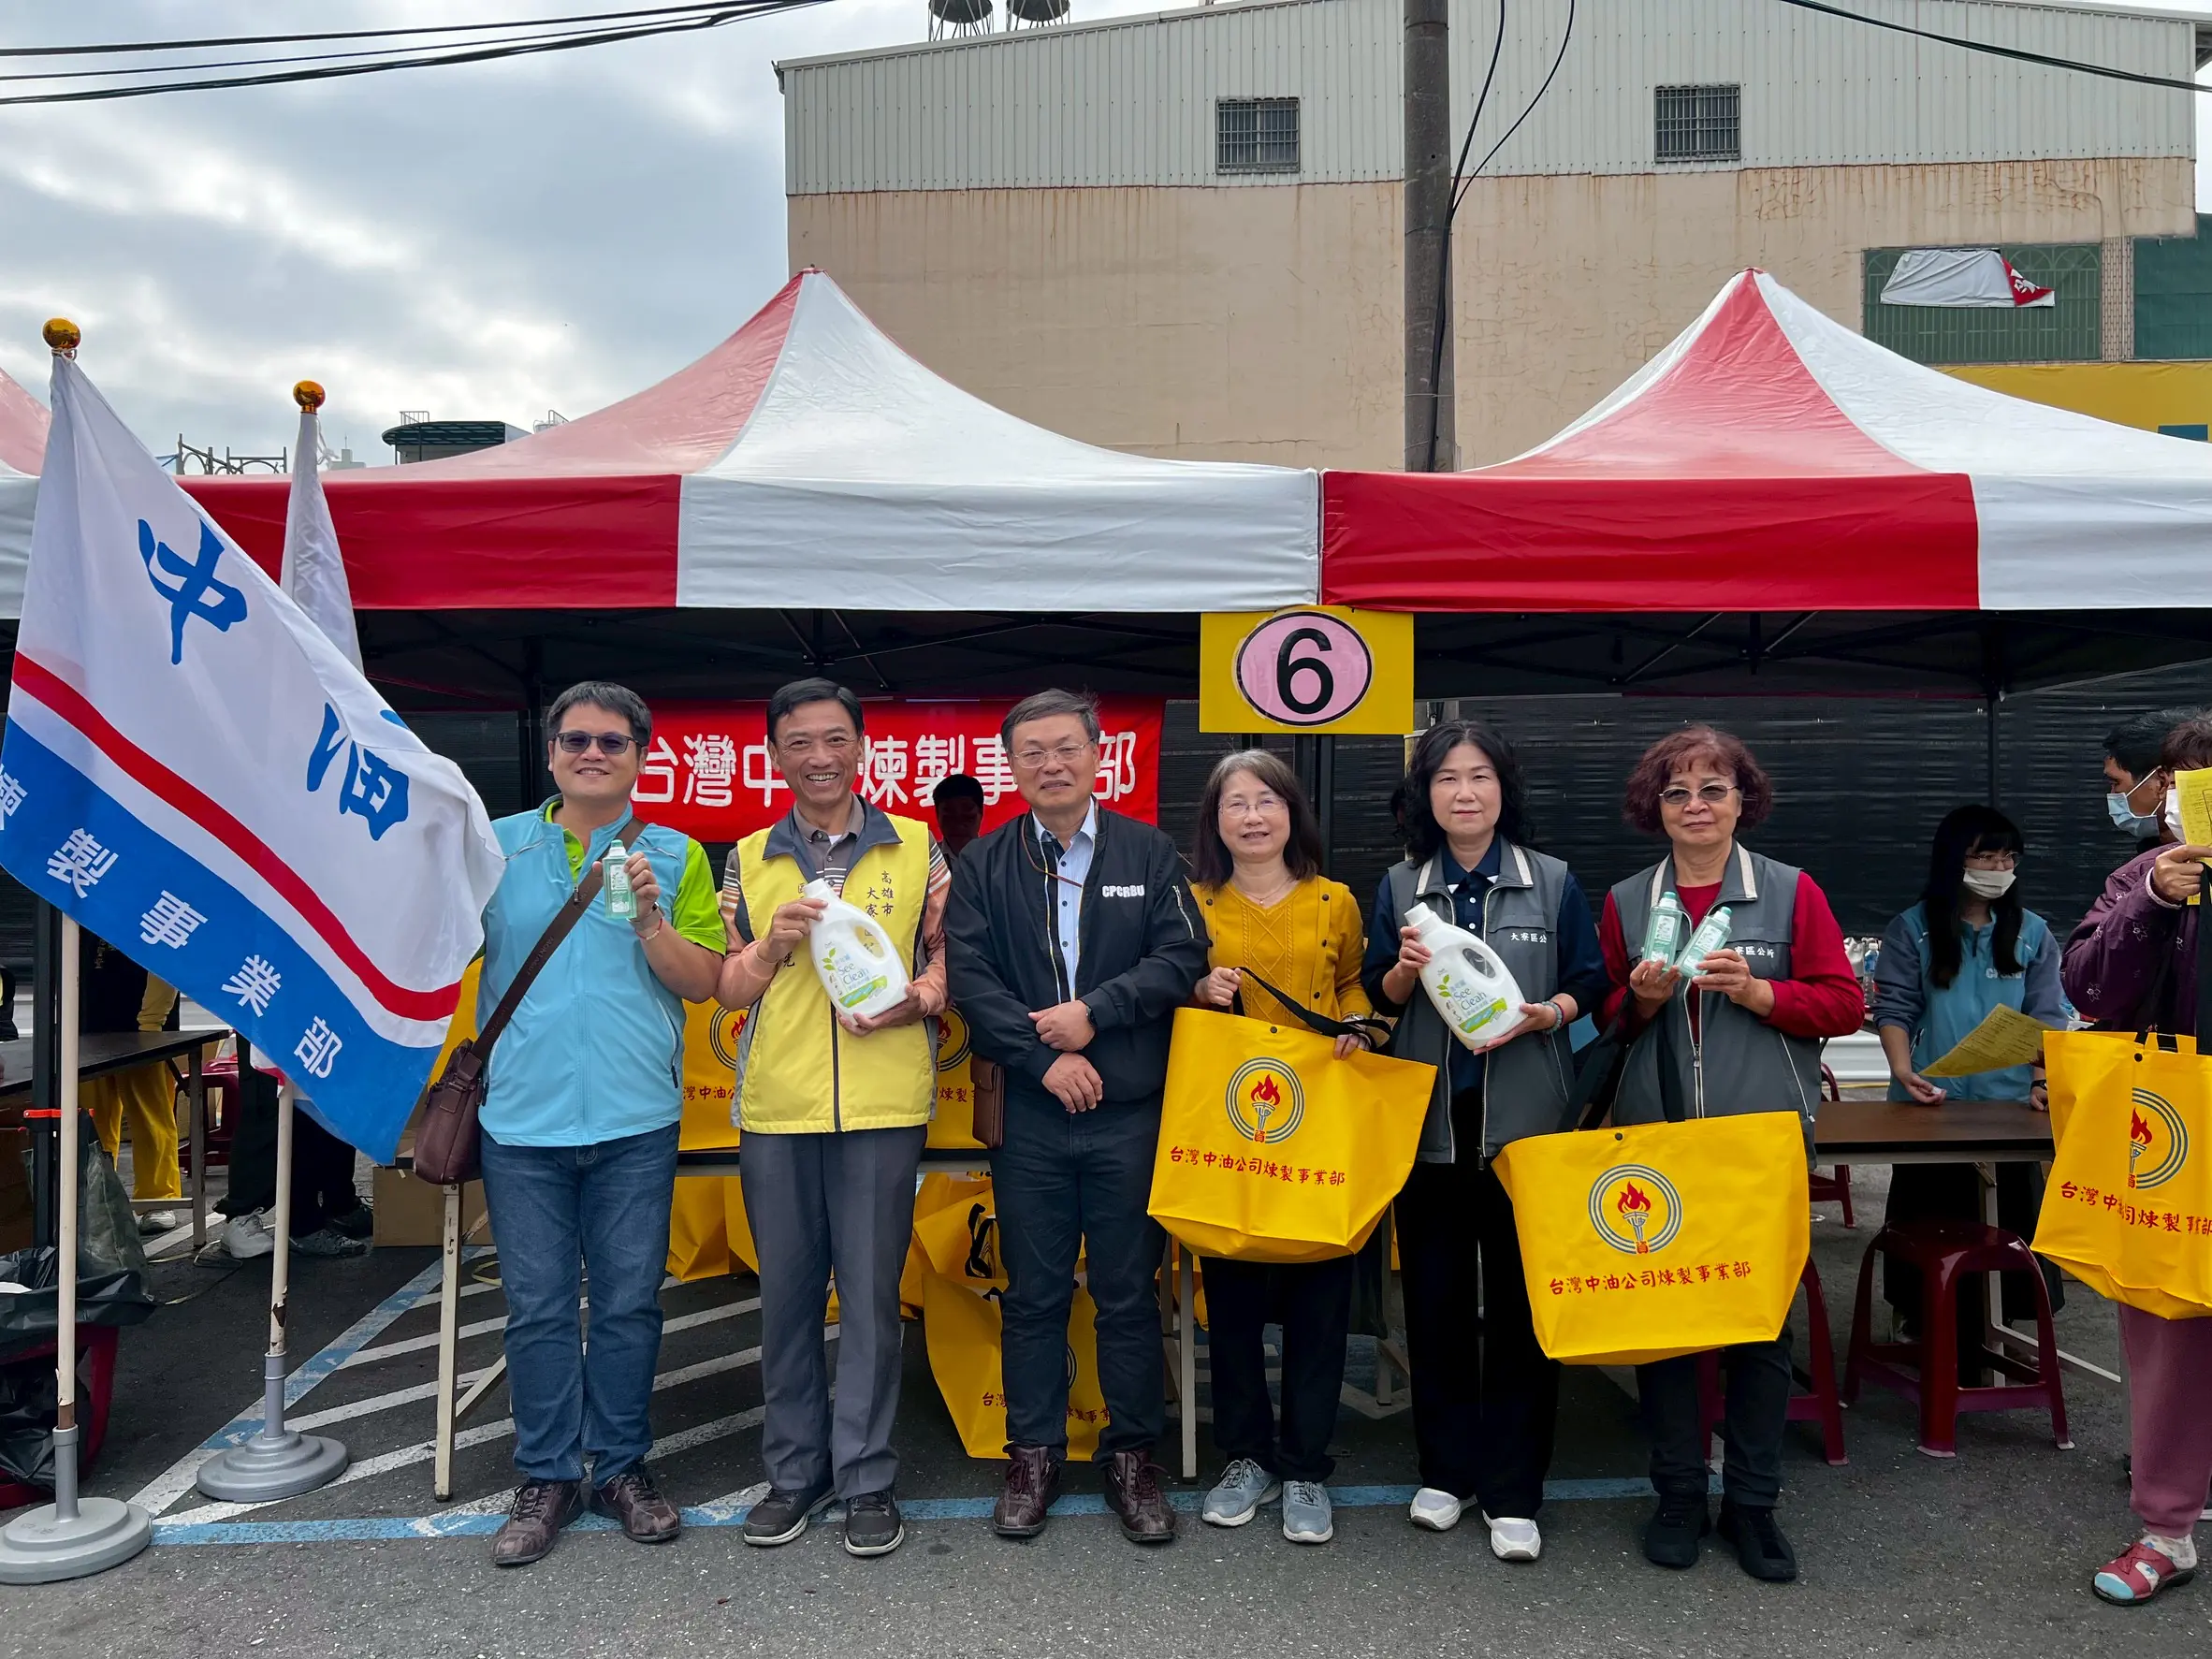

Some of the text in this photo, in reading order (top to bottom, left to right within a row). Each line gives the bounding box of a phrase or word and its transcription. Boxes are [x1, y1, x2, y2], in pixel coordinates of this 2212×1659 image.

[1276, 627, 1334, 715] 6
[630, 730, 1137, 810] 台灣中煉製事部
[880, 870, 895, 917] 高雄市
[1101, 884, 1145, 898] CPCRBU
[837, 962, 856, 975] See
[1453, 986, 1472, 1002] See
[1461, 991, 1487, 1011] Clean
[1170, 1144, 1346, 1186] 台灣中油公司煉製事業部
[1549, 1260, 1752, 1296] 台灣中油公司煉製事業部
